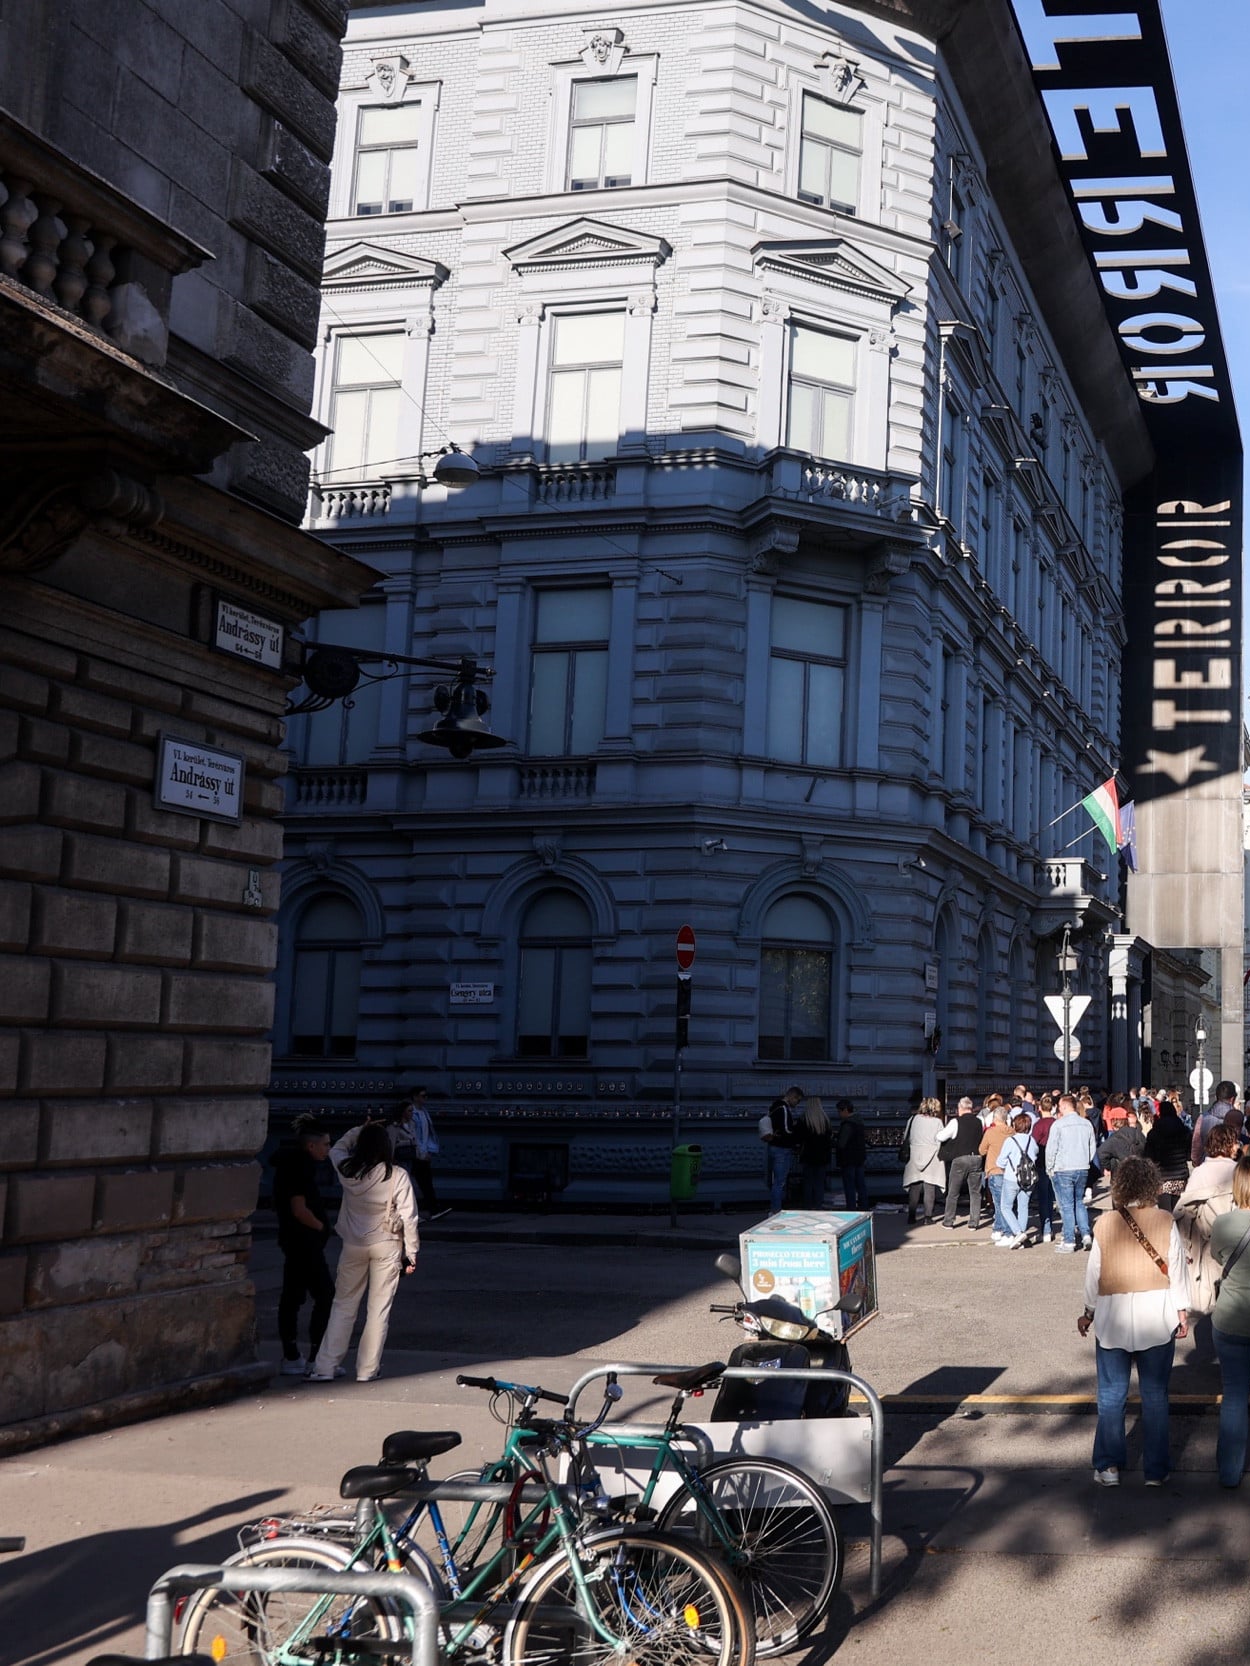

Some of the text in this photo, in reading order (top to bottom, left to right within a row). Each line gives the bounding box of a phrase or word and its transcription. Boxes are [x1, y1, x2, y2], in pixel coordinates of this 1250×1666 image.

[1152, 499, 1231, 731] TERROR
[218, 615, 280, 653] Andrássy út
[169, 762, 234, 796] Andrássy út
[752, 1258, 826, 1268] 3 min from here
